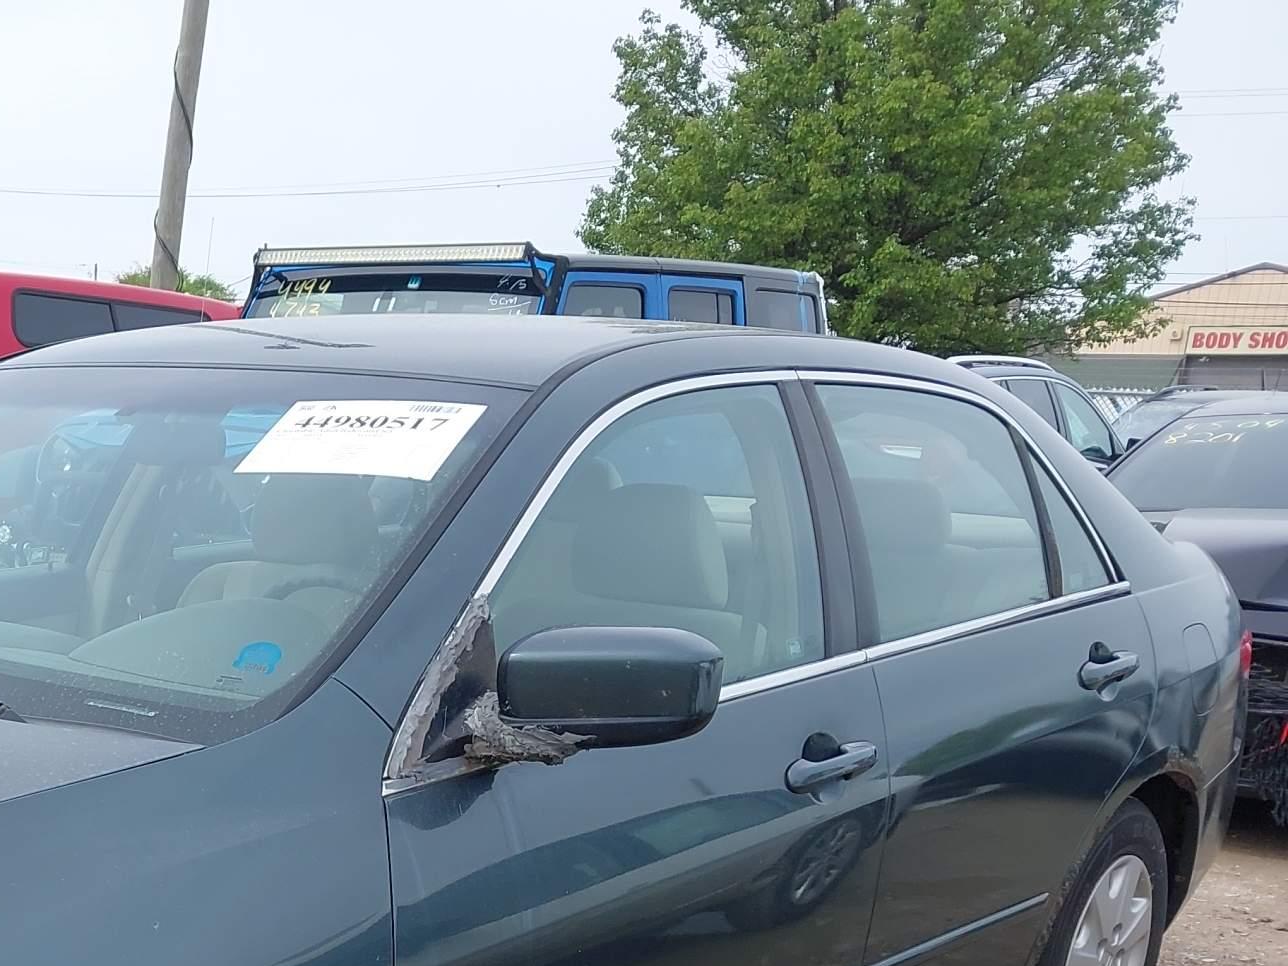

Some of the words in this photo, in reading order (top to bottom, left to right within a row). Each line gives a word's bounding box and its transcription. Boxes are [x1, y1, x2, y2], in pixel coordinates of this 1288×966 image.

[1191, 331, 1244, 350] BODY
[1248, 330, 1288, 350] SHO
[295, 415, 450, 432] 44980517
